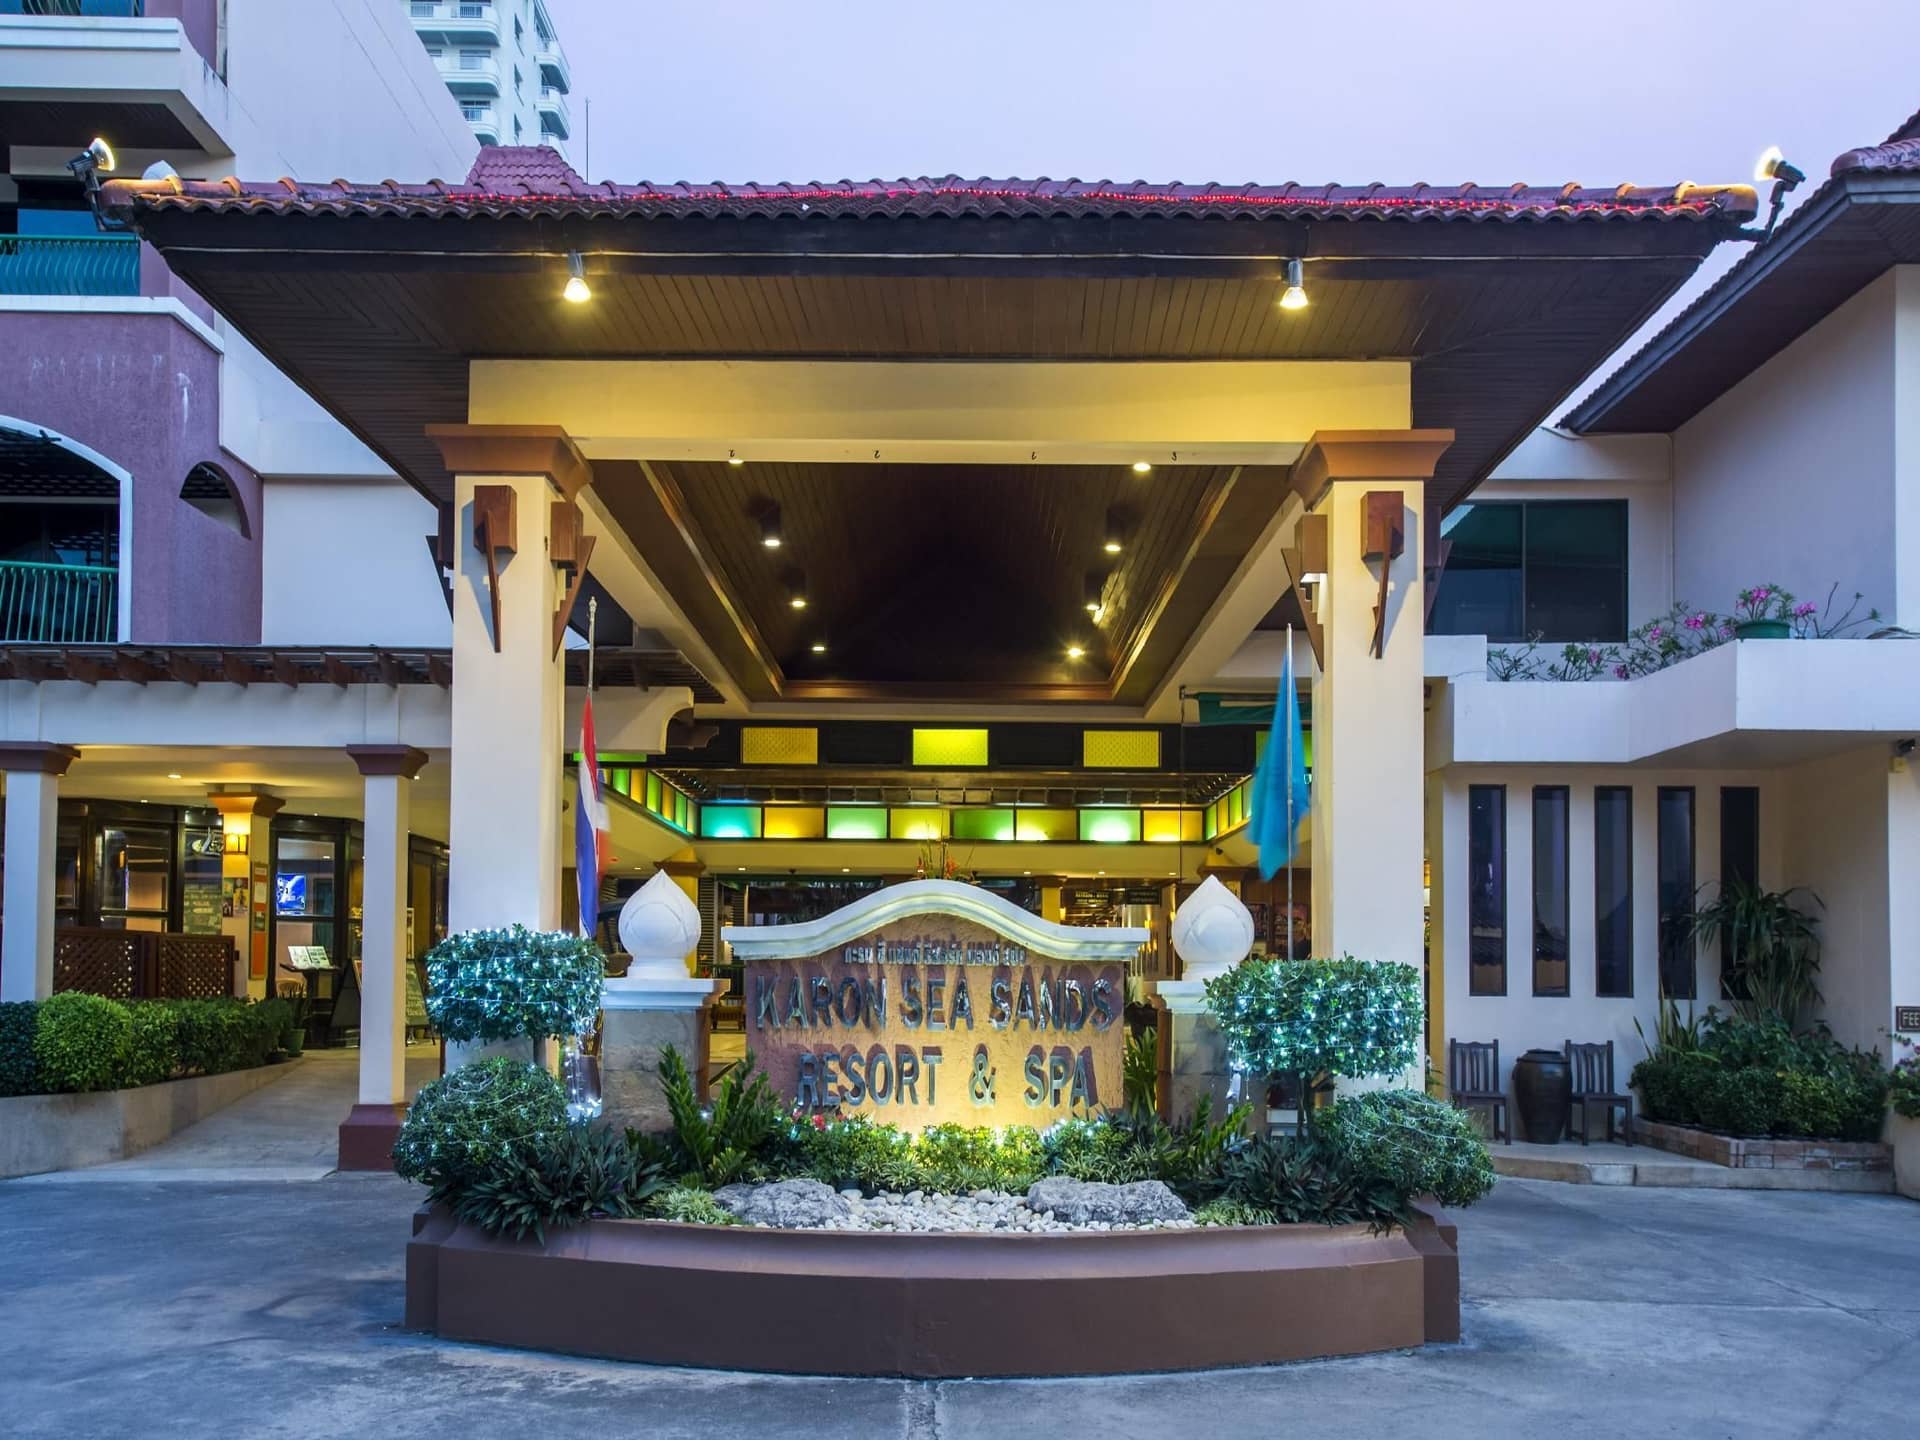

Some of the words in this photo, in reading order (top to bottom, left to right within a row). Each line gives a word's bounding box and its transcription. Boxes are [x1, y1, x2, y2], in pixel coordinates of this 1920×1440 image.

[755, 975, 887, 1030] KARON
[901, 975, 974, 1032] SEA
[988, 977, 1113, 1033] SANDS
[797, 1052, 943, 1107] RESORT
[968, 1053, 997, 1107] &
[1023, 1053, 1092, 1108] SPA
